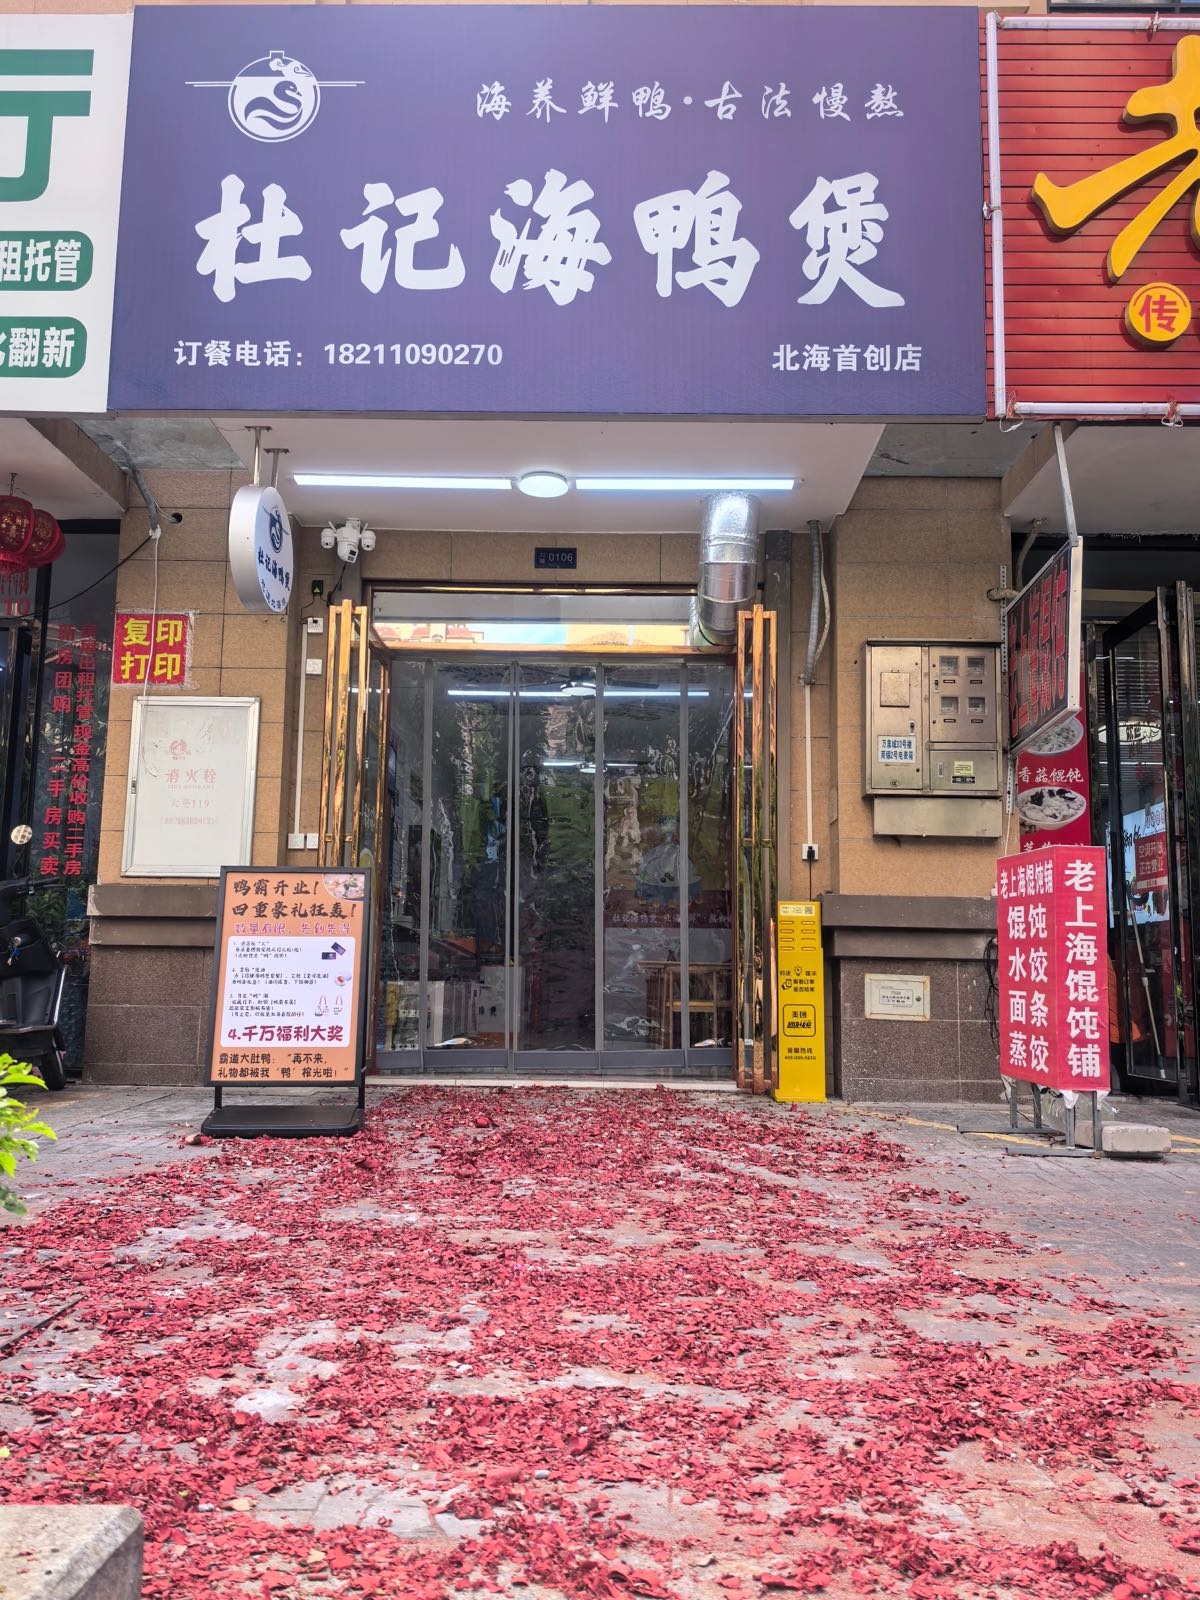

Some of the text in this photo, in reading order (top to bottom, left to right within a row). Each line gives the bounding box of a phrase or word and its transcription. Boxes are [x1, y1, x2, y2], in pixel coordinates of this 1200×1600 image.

[195, 168, 905, 308] 杜记海鸭煲
[1138, 294, 1180, 333] 传
[0, 326, 75, 368] 翻新
[174, 340, 503, 367] 订餐电话： 18211090270
[771, 344, 922, 372] 北海首创店
[548, 552, 573, 562] 0106
[122, 618, 183, 646] 复印
[121, 651, 181, 680] 打印
[164, 768, 217, 784] 消火栓
[1018, 767, 1084, 783] 香菇馄饨
[40, 756, 67, 876] 二手房买卖
[1000, 859, 1053, 899] 老上海馄饨铺
[1007, 903, 1047, 939] 馄饨
[1008, 947, 1048, 983] 水饺
[1064, 859, 1101, 1077] 老上海馄饨铺
[1009, 990, 1049, 1028] 面条
[1009, 1030, 1049, 1074] 蒸饺
